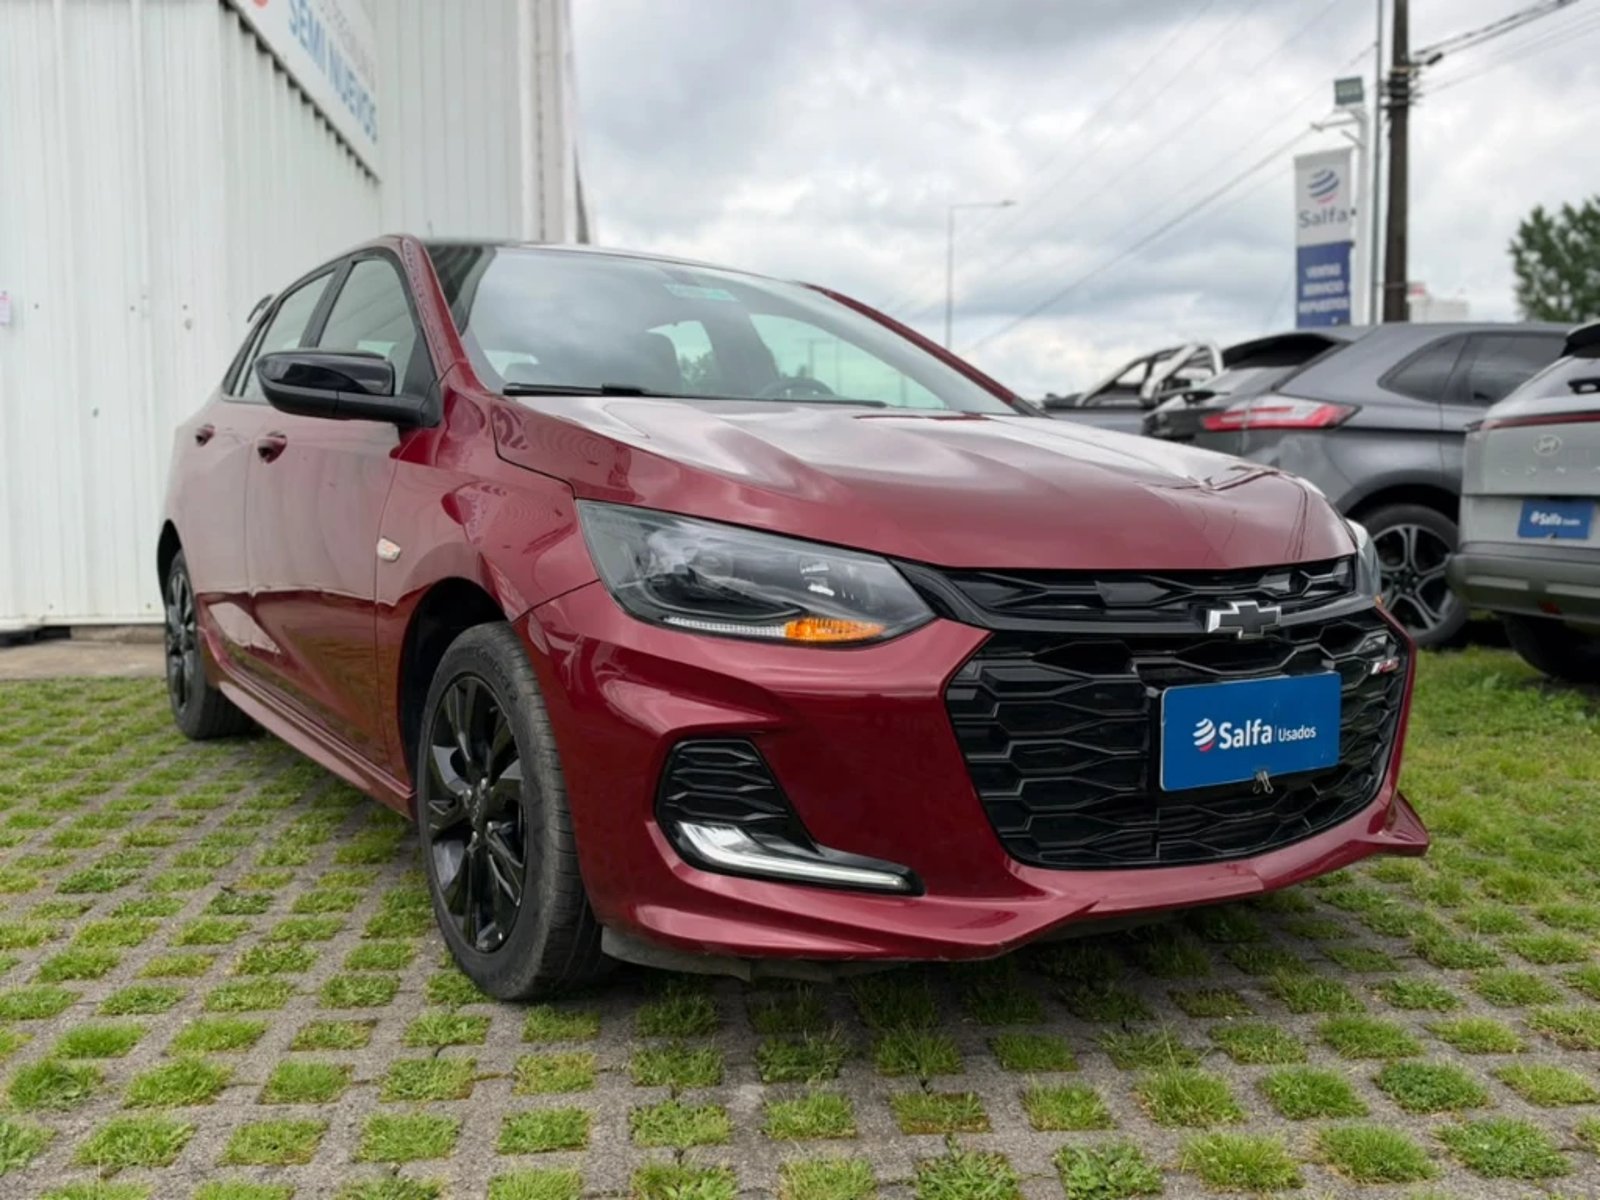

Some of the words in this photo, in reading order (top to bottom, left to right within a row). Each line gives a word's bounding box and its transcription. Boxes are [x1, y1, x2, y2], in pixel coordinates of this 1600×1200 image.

[1299, 207, 1348, 228] Salfa
[1218, 718, 1273, 750] Salfa
[1278, 726, 1317, 743] Usados
